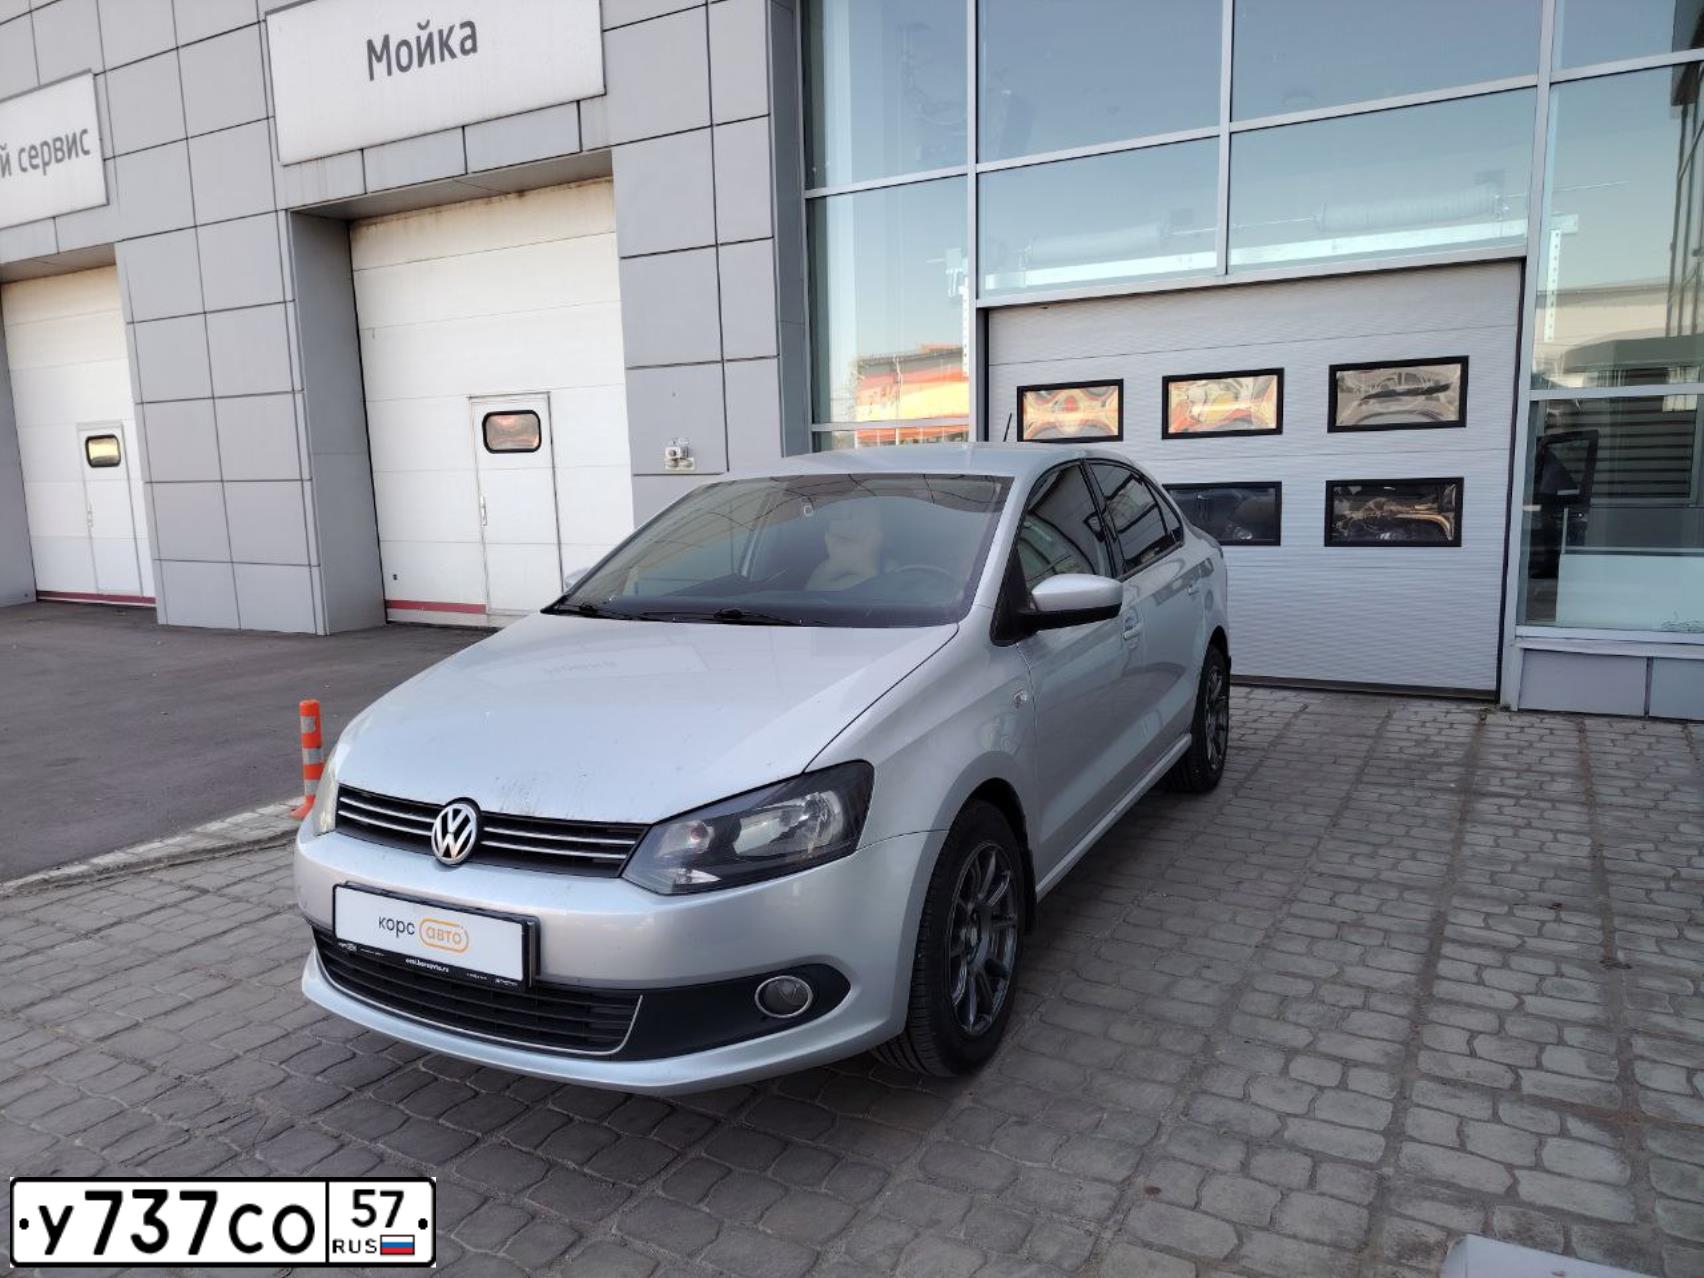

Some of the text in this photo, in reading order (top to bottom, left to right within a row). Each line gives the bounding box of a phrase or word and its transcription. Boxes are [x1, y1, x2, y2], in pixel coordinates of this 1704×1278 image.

[366, 19, 478, 81] Мойка
[18, 128, 91, 176] сервис
[378, 916, 462, 945] корс авто
